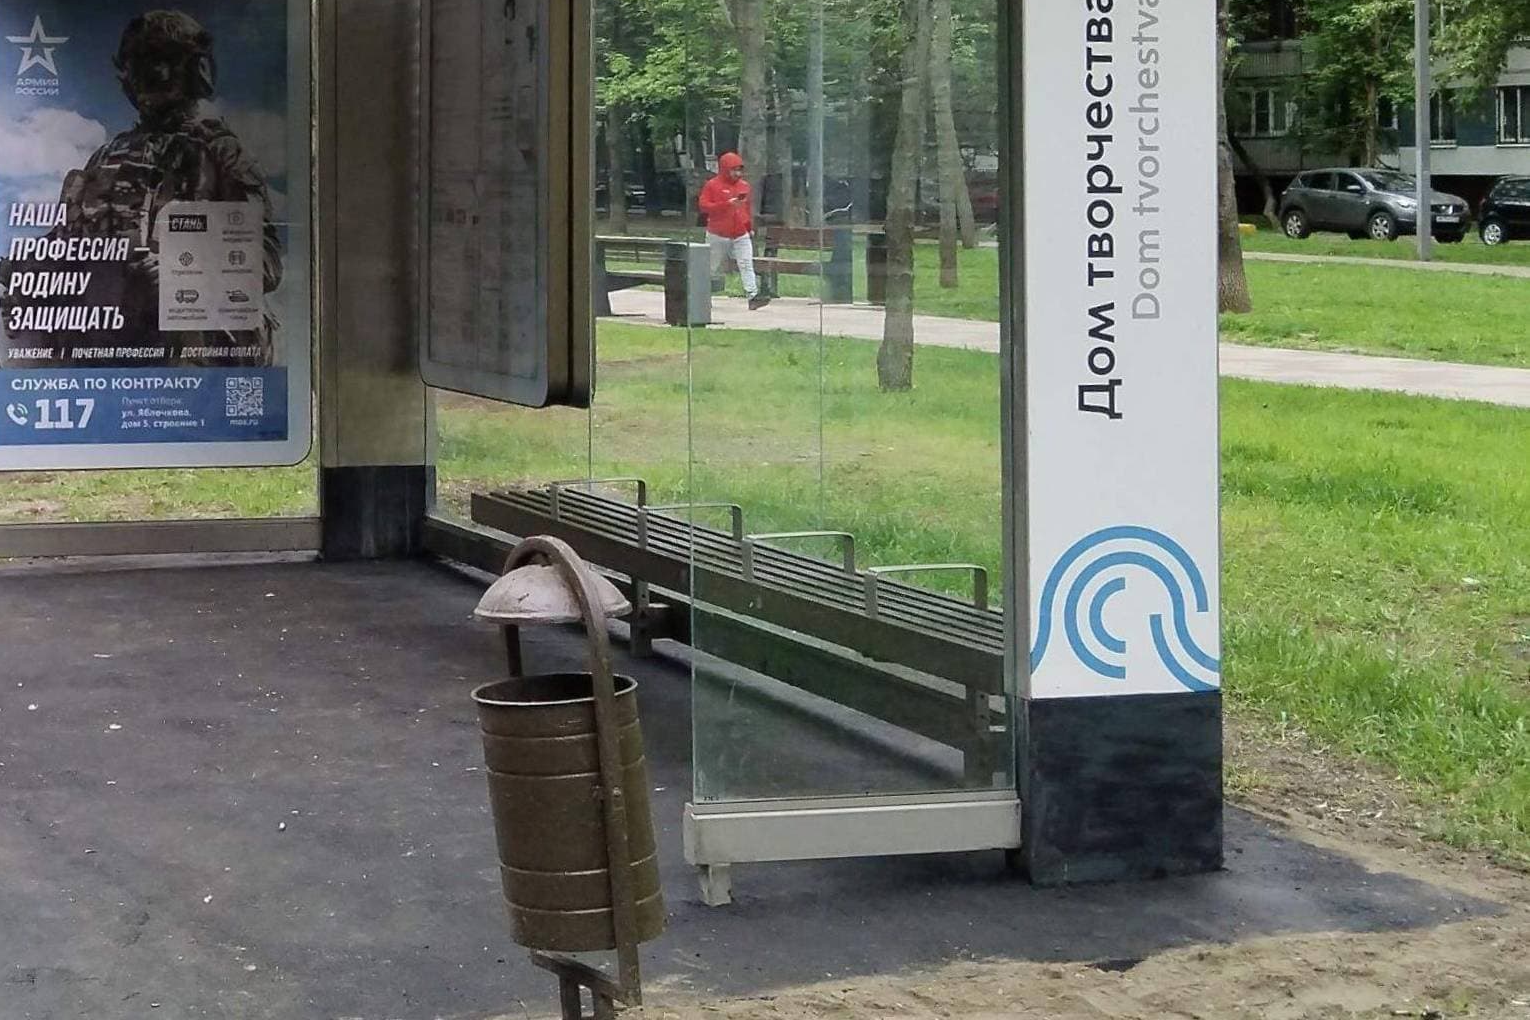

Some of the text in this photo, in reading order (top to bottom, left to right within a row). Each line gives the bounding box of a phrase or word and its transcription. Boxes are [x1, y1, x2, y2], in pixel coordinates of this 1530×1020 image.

[15, 87, 59, 95] РОССИИ
[8, 203, 67, 227] НАША
[8, 237, 130, 261] ПРОФЕССИЯ
[8, 272, 91, 299] РОДИНУ
[1132, 230, 1161, 319] Dom
[8, 306, 124, 333] ЗАЩИЩАТЬ
[8, 348, 54, 359] УВАЖЕНИЕ
[71, 347, 165, 358] ПОЧЕТНАЯ ПРОФЕССИЯ
[1078, 302, 1123, 419] Дом
[11, 377, 203, 391] СЛУЖБА ПО КОНТРАКТУ
[35, 398, 95, 429] 117
[121, 421, 141, 429] дом
